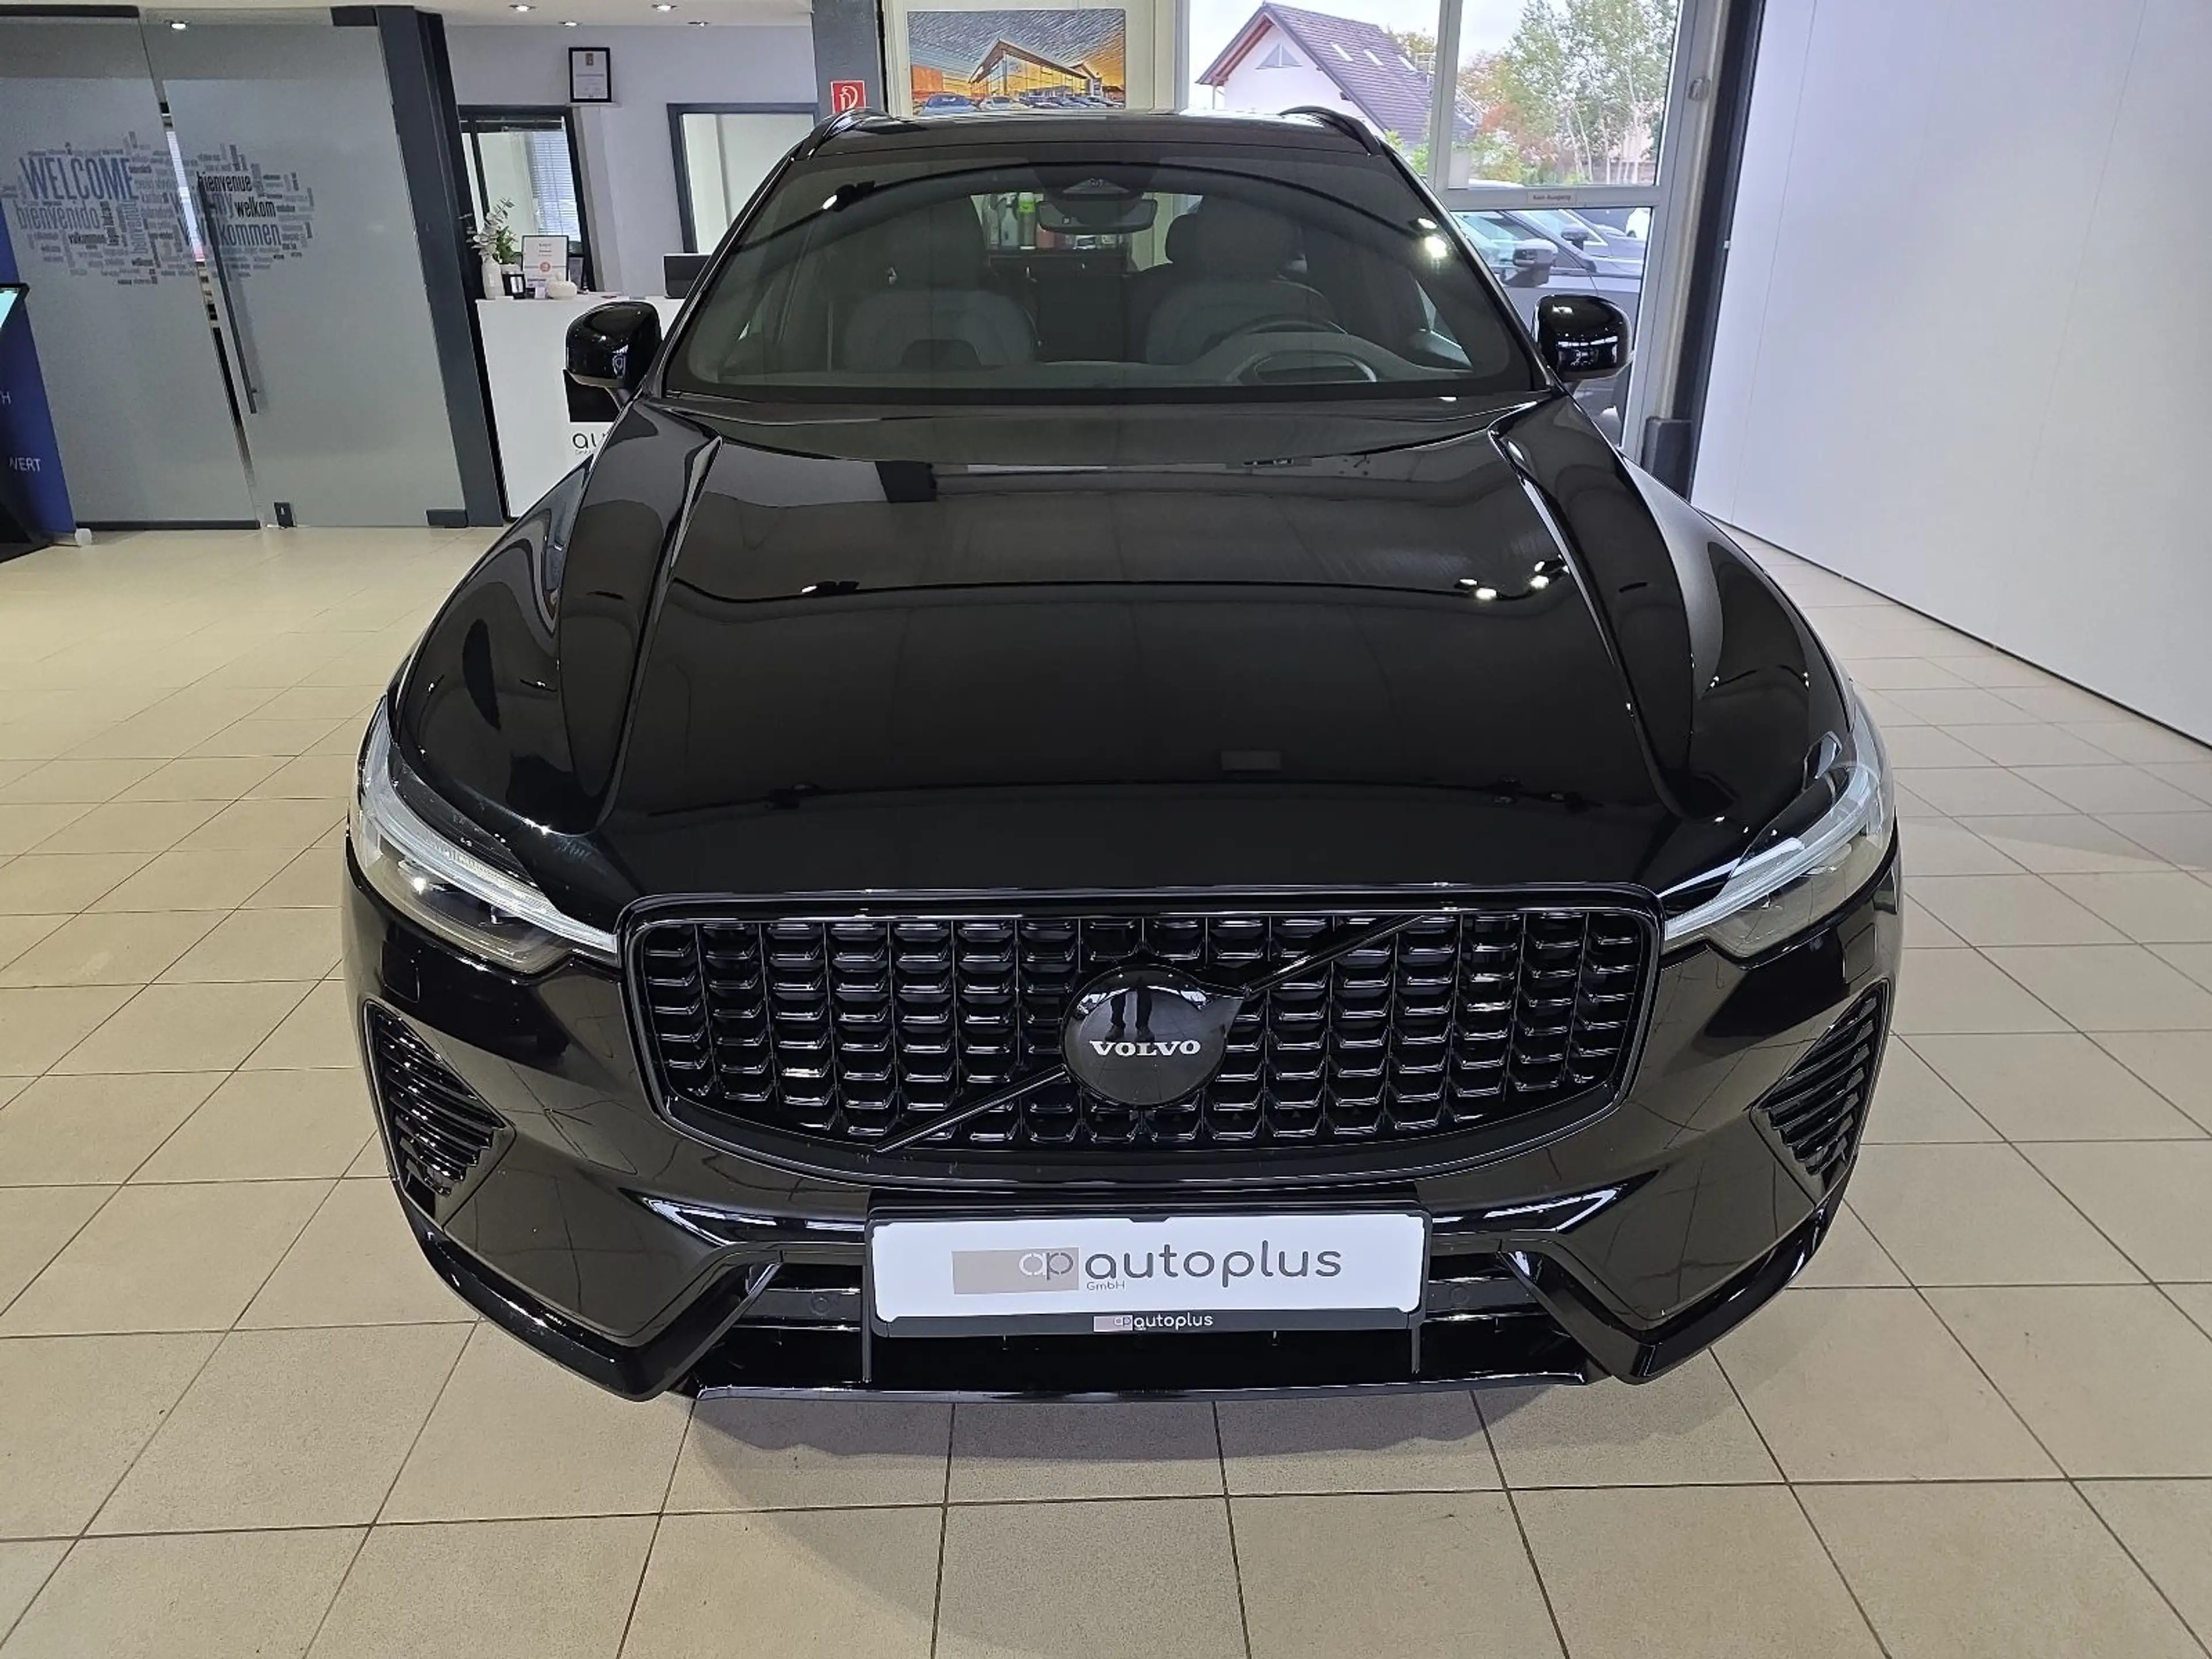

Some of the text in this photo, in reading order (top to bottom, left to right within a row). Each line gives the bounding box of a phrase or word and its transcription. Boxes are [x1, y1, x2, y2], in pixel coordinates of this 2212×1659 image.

[19, 157, 139, 200] WELCOME
[13, 199, 100, 229] bienvenido
[234, 196, 276, 218] welkom
[1089, 1040, 1201, 1056] VOLVO
[1085, 1240, 1342, 1287] autoplus
[1086, 1281, 1125, 1291] GmbH
[1134, 1312, 1213, 1331] autoplus
